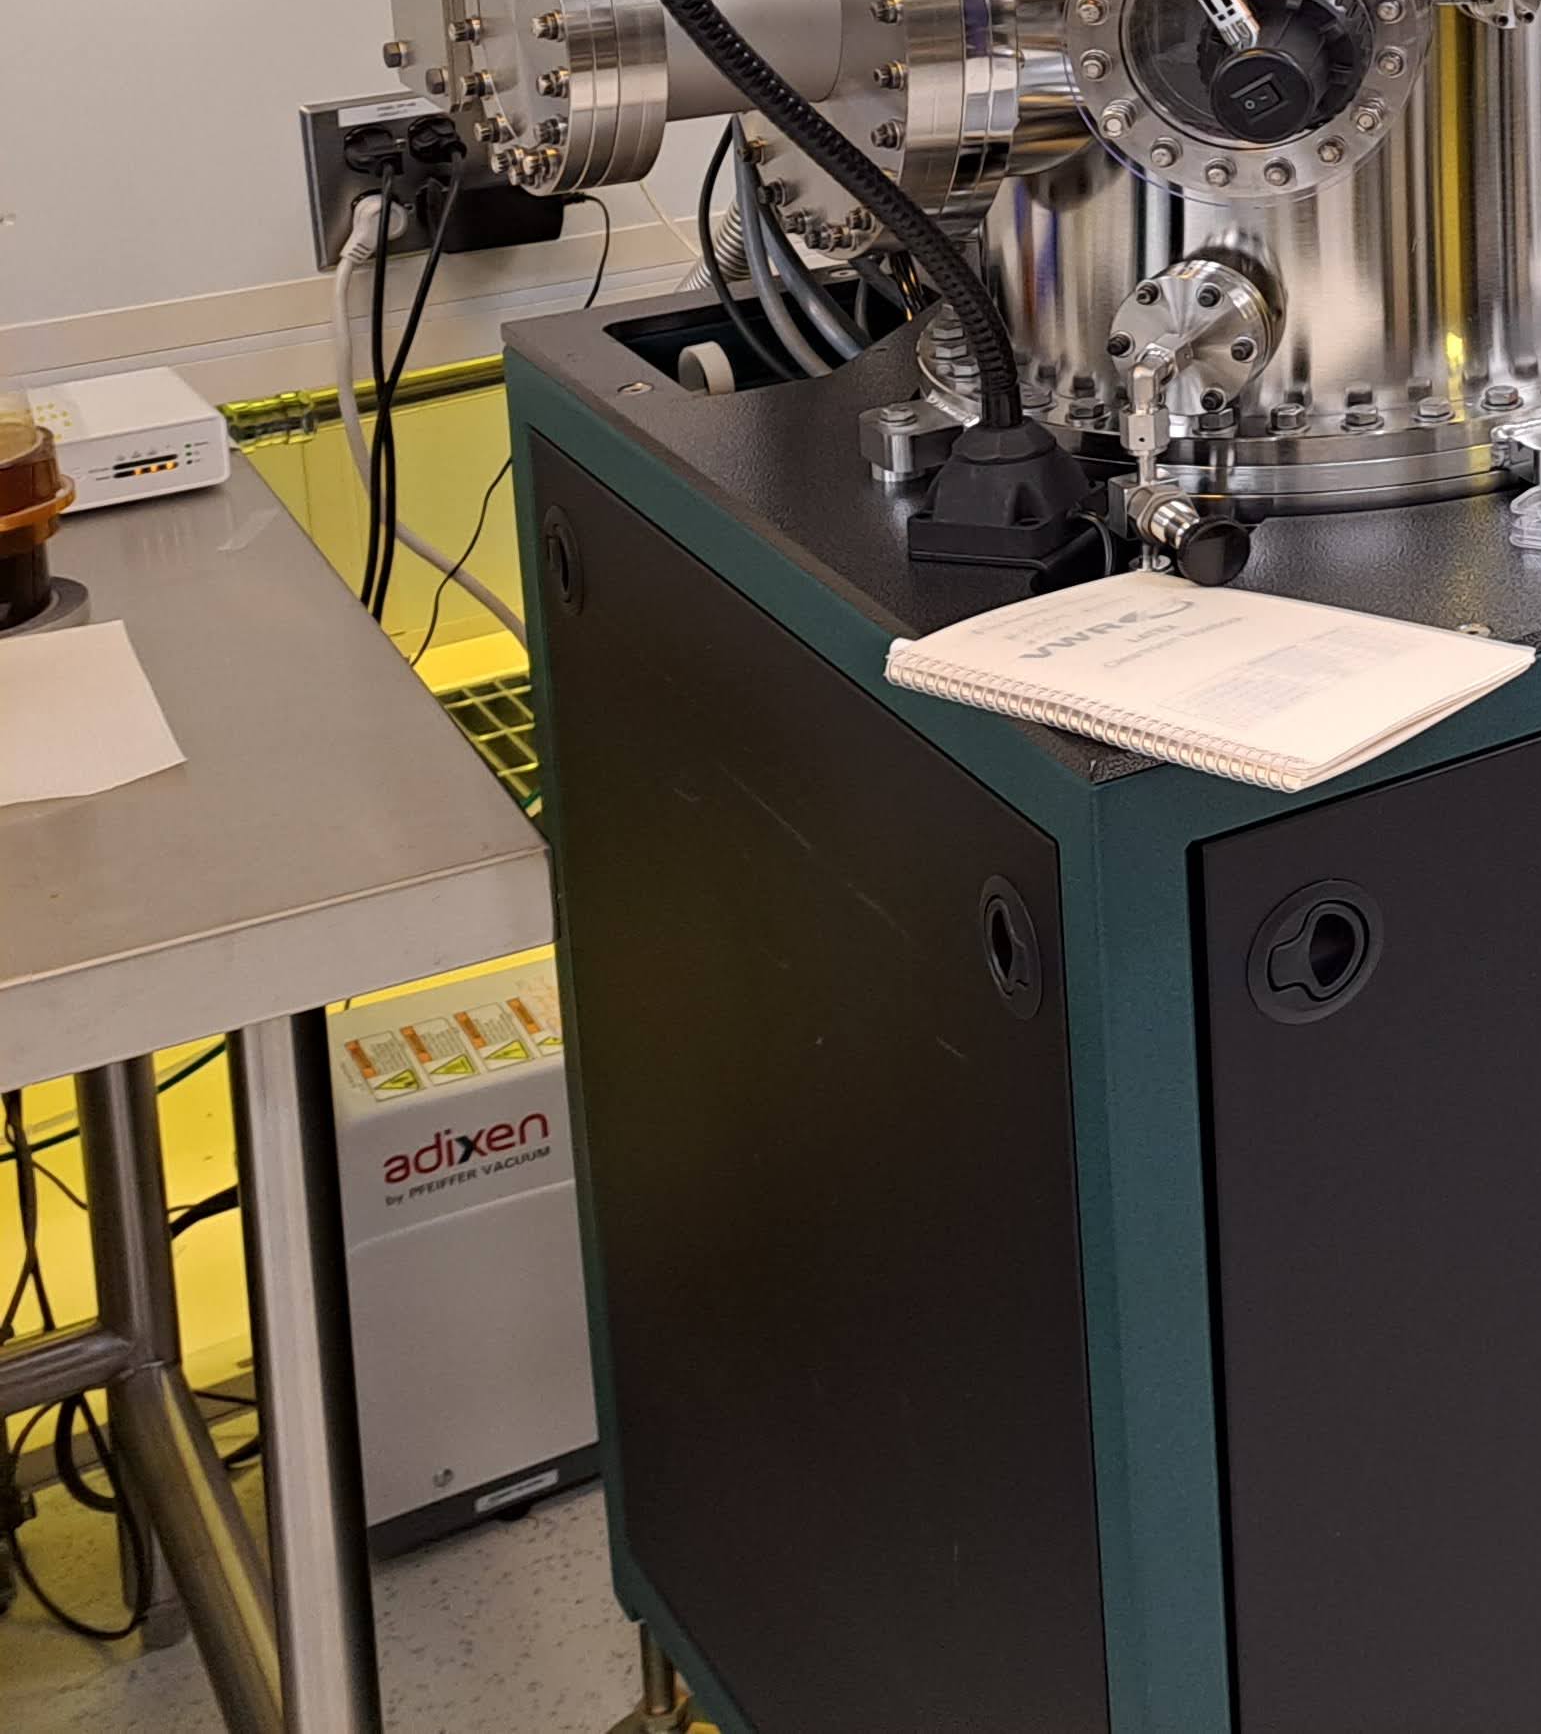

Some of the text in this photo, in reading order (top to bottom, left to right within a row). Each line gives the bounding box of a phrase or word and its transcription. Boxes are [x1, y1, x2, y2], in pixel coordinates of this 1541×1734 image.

[383, 1113, 550, 1185] adixen
[408, 1168, 478, 1199] PFEIFFER
[481, 1145, 551, 1176] VACUUM
